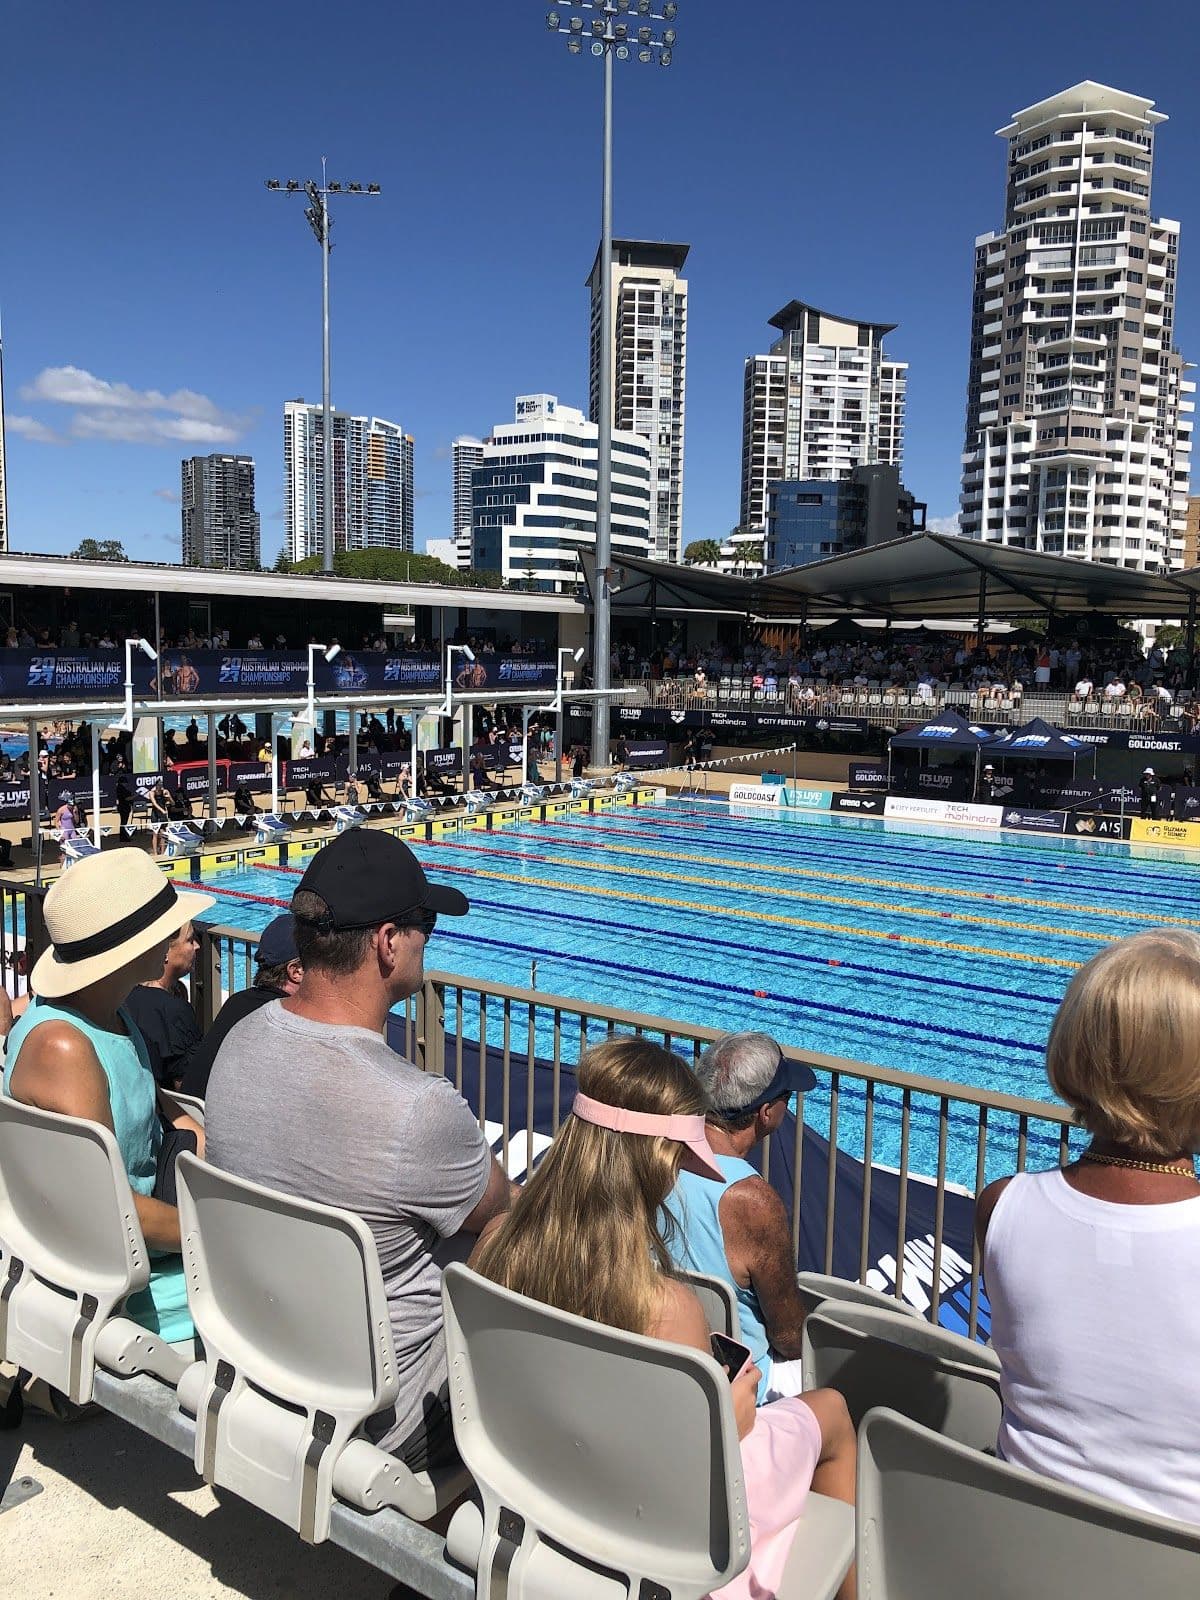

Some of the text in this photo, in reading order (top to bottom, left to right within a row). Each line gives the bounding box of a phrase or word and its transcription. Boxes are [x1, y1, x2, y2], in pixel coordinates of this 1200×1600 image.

[56, 662, 121, 673] AUSTRALIAN AGE
[241, 661, 280, 672] AUSTRALIAN
[56, 673, 119, 685] CHAMPIONSHIPS
[241, 672, 291, 682] CHAMPIONSHIPS
[710, 718, 747, 726] mahindra
[777, 718, 807, 727] FERTILITY
[360, 763, 372, 772] AIS
[6, 789, 31, 801] LIVE!
[1060, 788, 1092, 797] FERTILITY
[1110, 788, 1134, 796] TECH
[945, 805, 969, 813] TECH
[944, 812, 998, 824] mahindra
[1099, 821, 1121, 833] AIS
